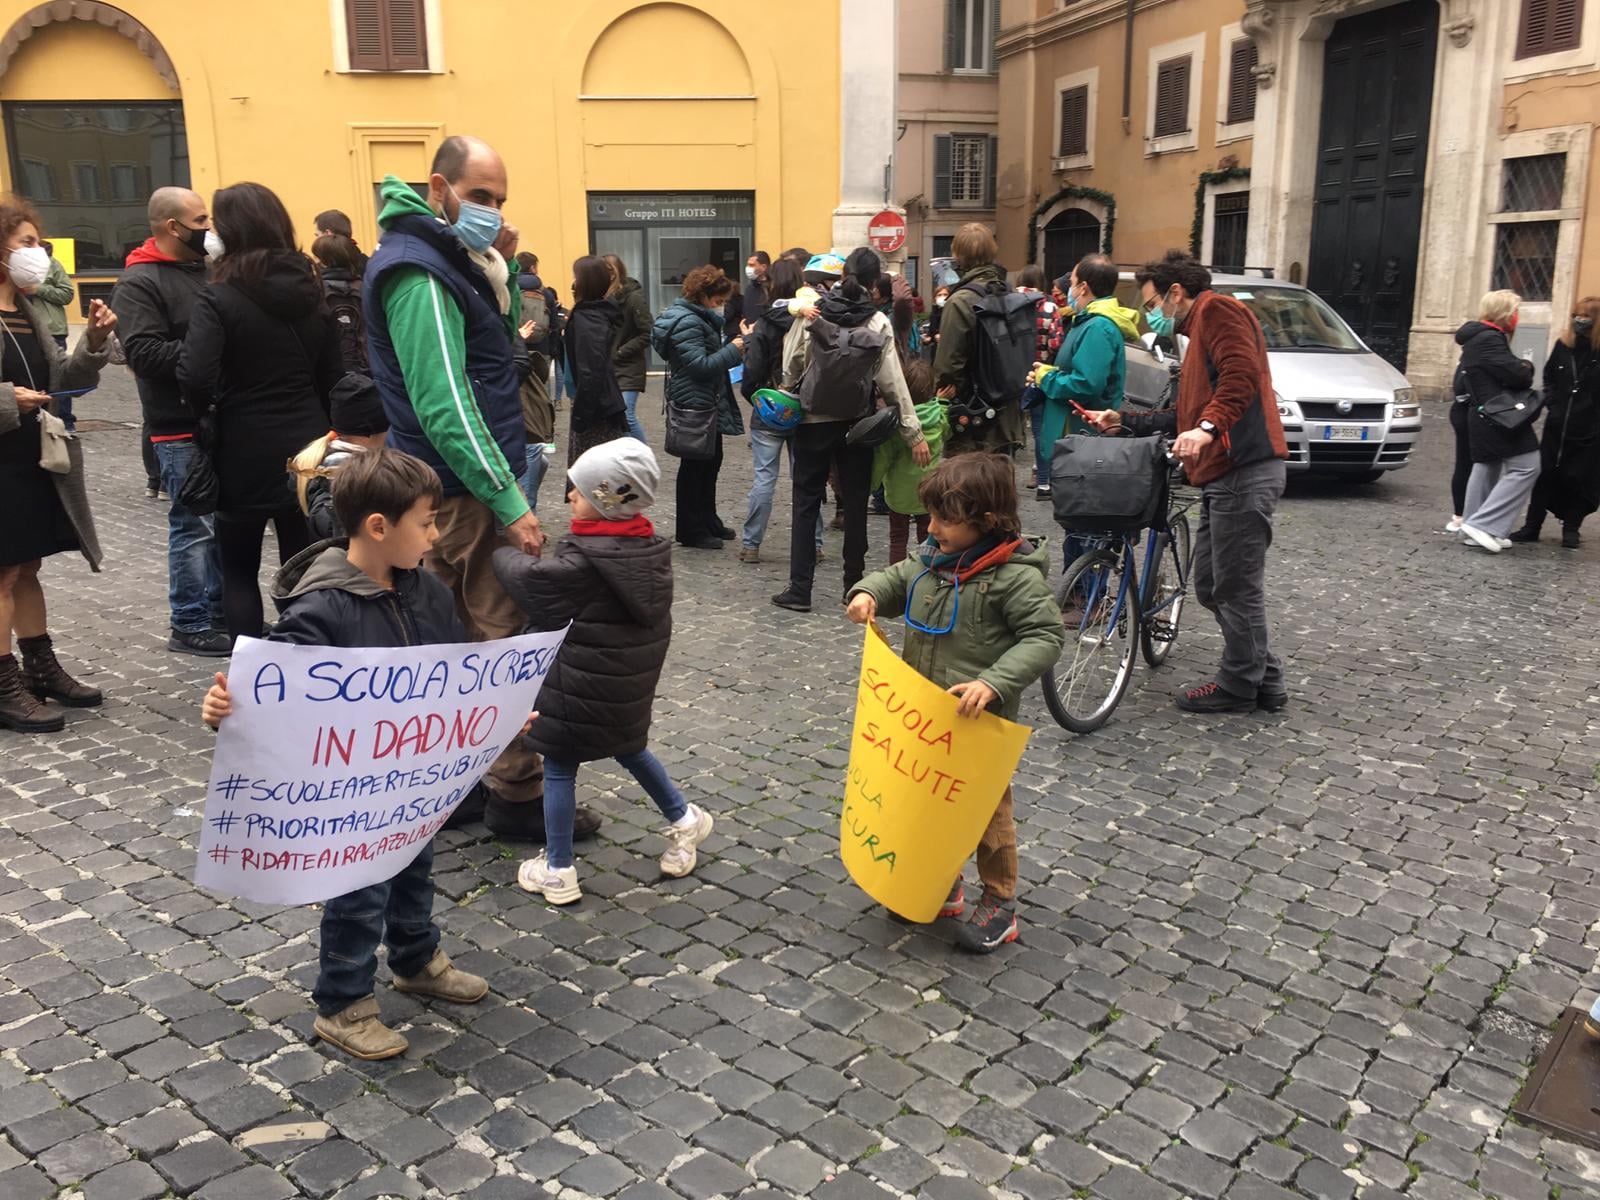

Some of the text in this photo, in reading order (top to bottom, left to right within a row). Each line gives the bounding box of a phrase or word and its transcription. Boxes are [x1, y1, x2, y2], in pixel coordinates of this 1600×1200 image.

[624, 208, 717, 220] Gruppo ITI HOTELS
[254, 662, 285, 704] A
[305, 661, 449, 702] SCUOLA
[863, 667, 952, 755] SCUOLA
[312, 726, 356, 767] IN
[861, 722, 967, 803] SALUTE
